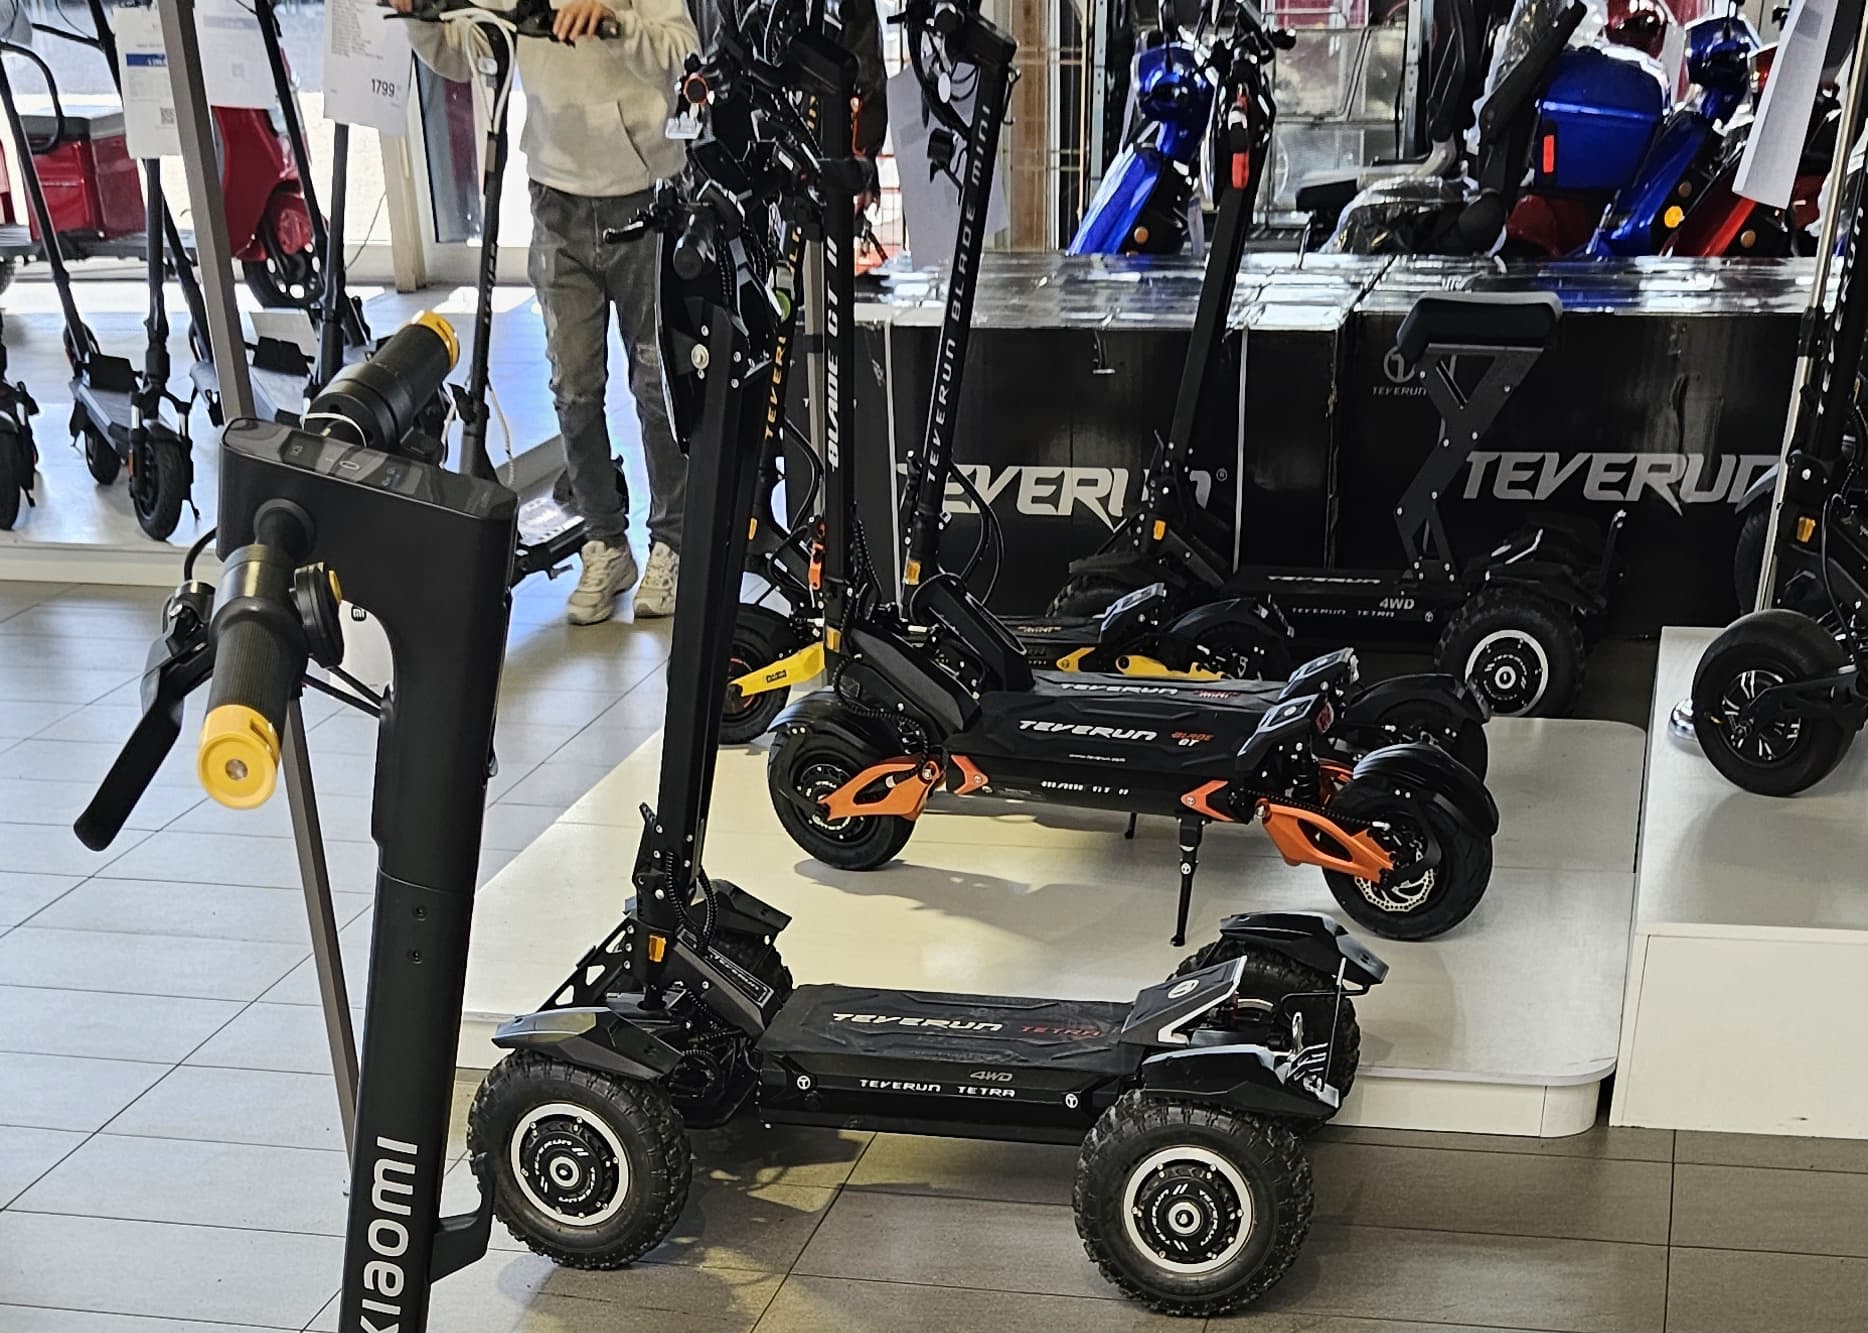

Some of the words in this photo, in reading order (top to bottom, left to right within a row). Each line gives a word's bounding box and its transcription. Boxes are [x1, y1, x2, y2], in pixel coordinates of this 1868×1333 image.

[371, 78, 396, 98] 1799
[925, 339, 957, 484] TEVERUN
[950, 203, 976, 323] BLADE
[969, 103, 991, 187] MINI
[764, 335, 787, 440] TEVER
[1379, 598, 1416, 610] 4WD
[1018, 720, 1158, 742] TEVERUN
[832, 1012, 1004, 1032] TEVERUN
[970, 1069, 1014, 1083] 4WD
[859, 1078, 942, 1093] TEVERUN
[956, 1085, 1016, 1098] TETRA
